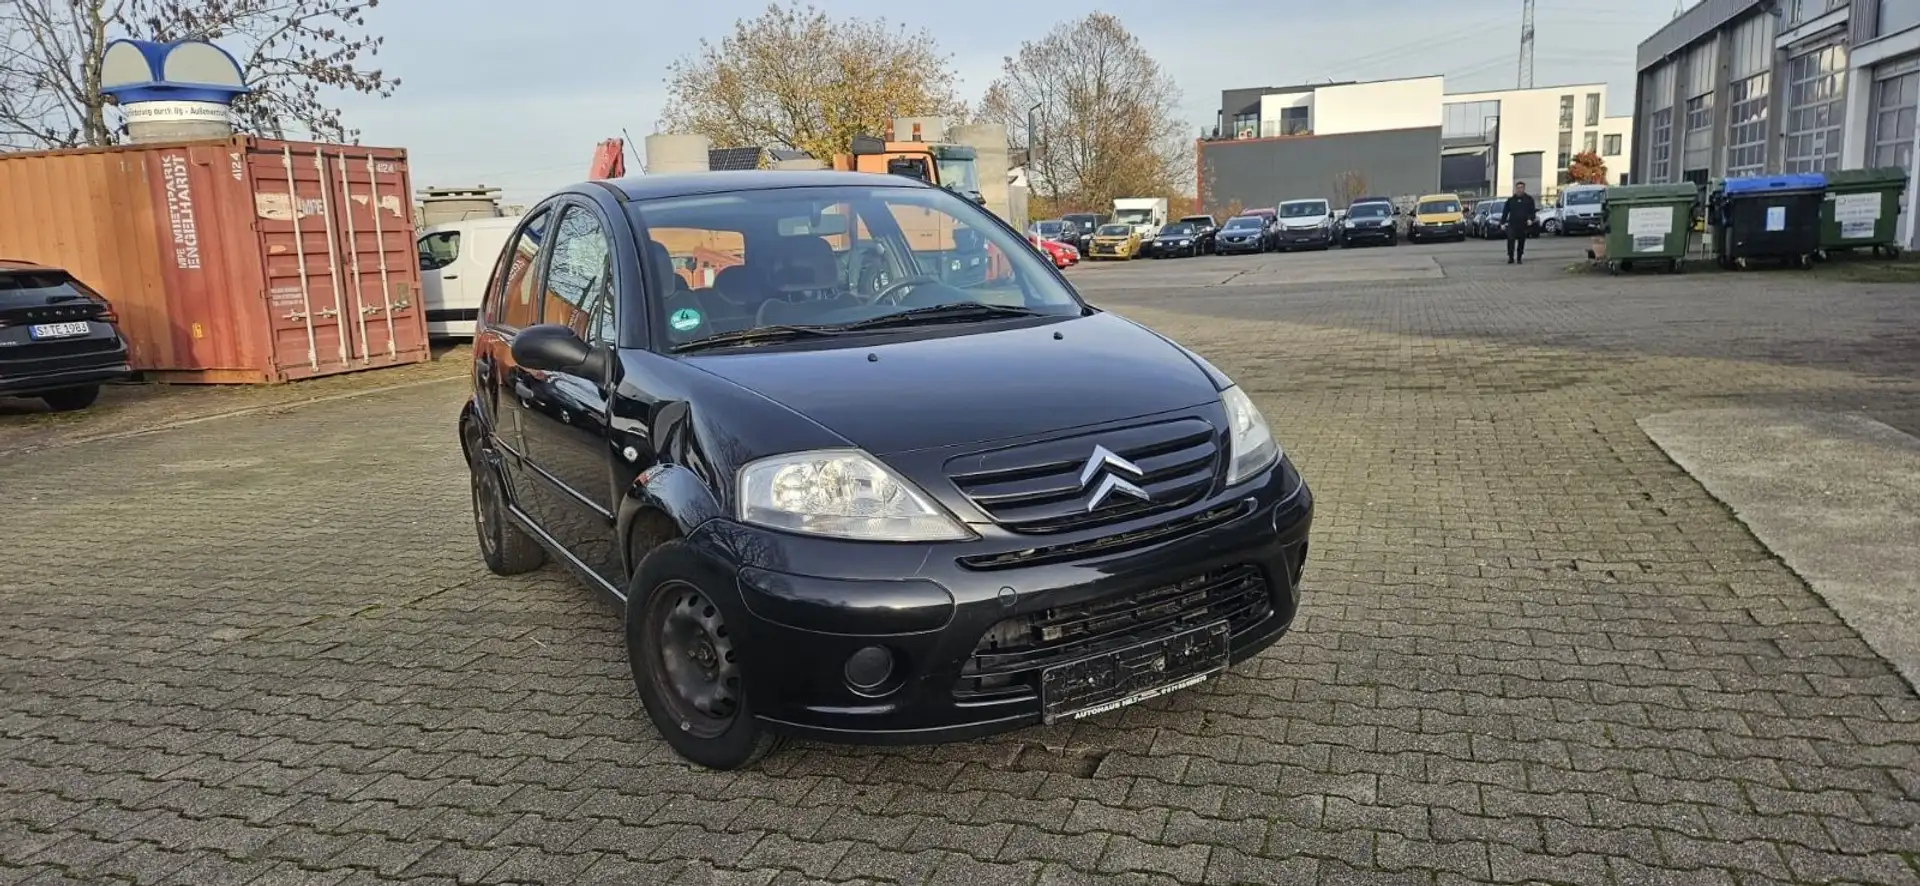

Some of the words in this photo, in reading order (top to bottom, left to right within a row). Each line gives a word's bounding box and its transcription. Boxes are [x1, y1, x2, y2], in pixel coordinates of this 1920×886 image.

[230, 152, 243, 181] 4124
[161, 155, 183, 243] MIETPARK
[172, 154, 200, 269] ENGELHARDT
[1074, 702, 1121, 720] AUTOHAUS
